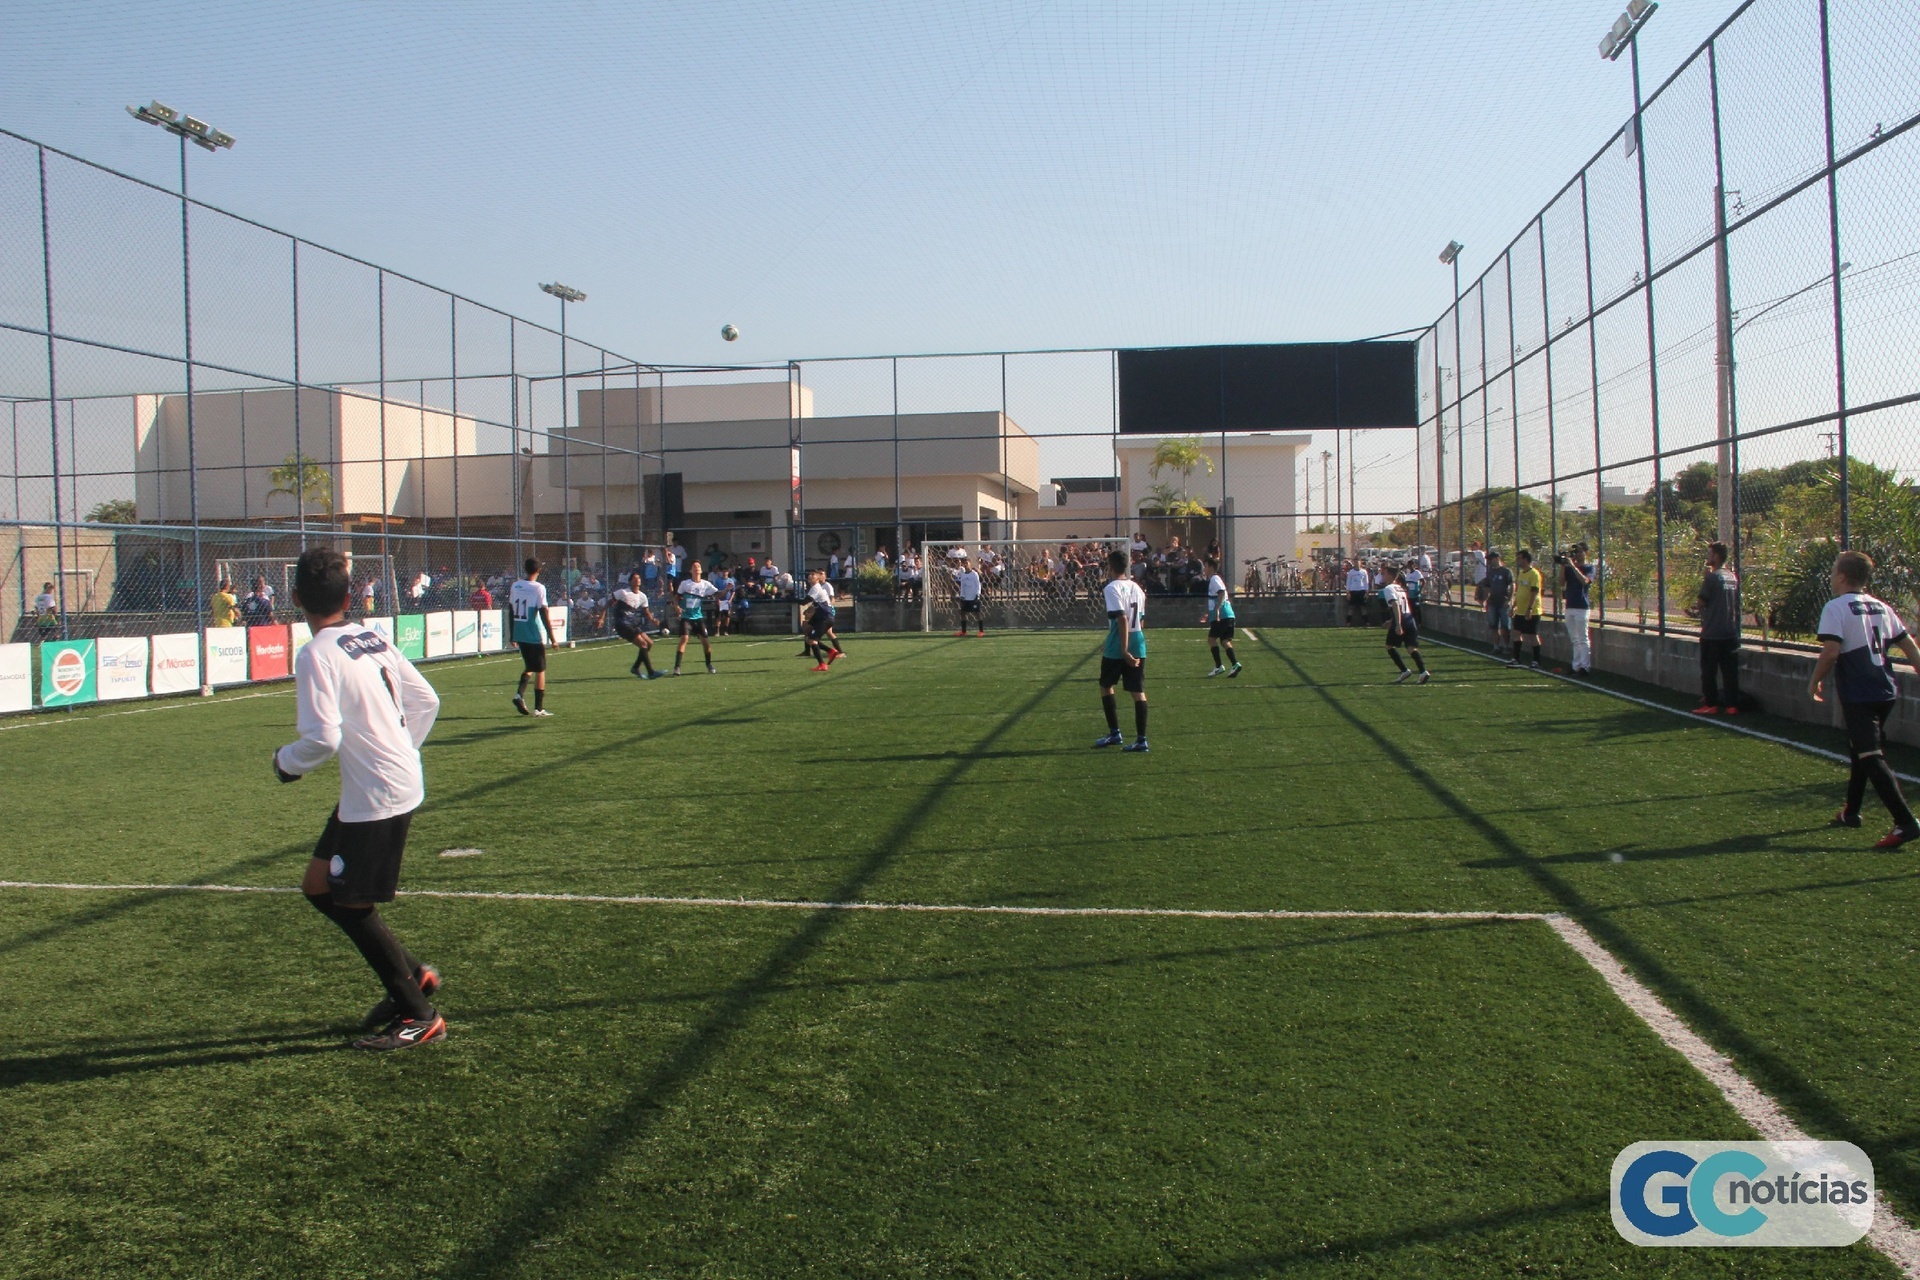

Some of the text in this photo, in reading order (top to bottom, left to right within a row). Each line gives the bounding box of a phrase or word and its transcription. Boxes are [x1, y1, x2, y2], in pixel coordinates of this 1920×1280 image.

[513, 598, 527, 619] 11
[1130, 602, 1138, 628] 7
[218, 646, 243, 657] SICOOB
